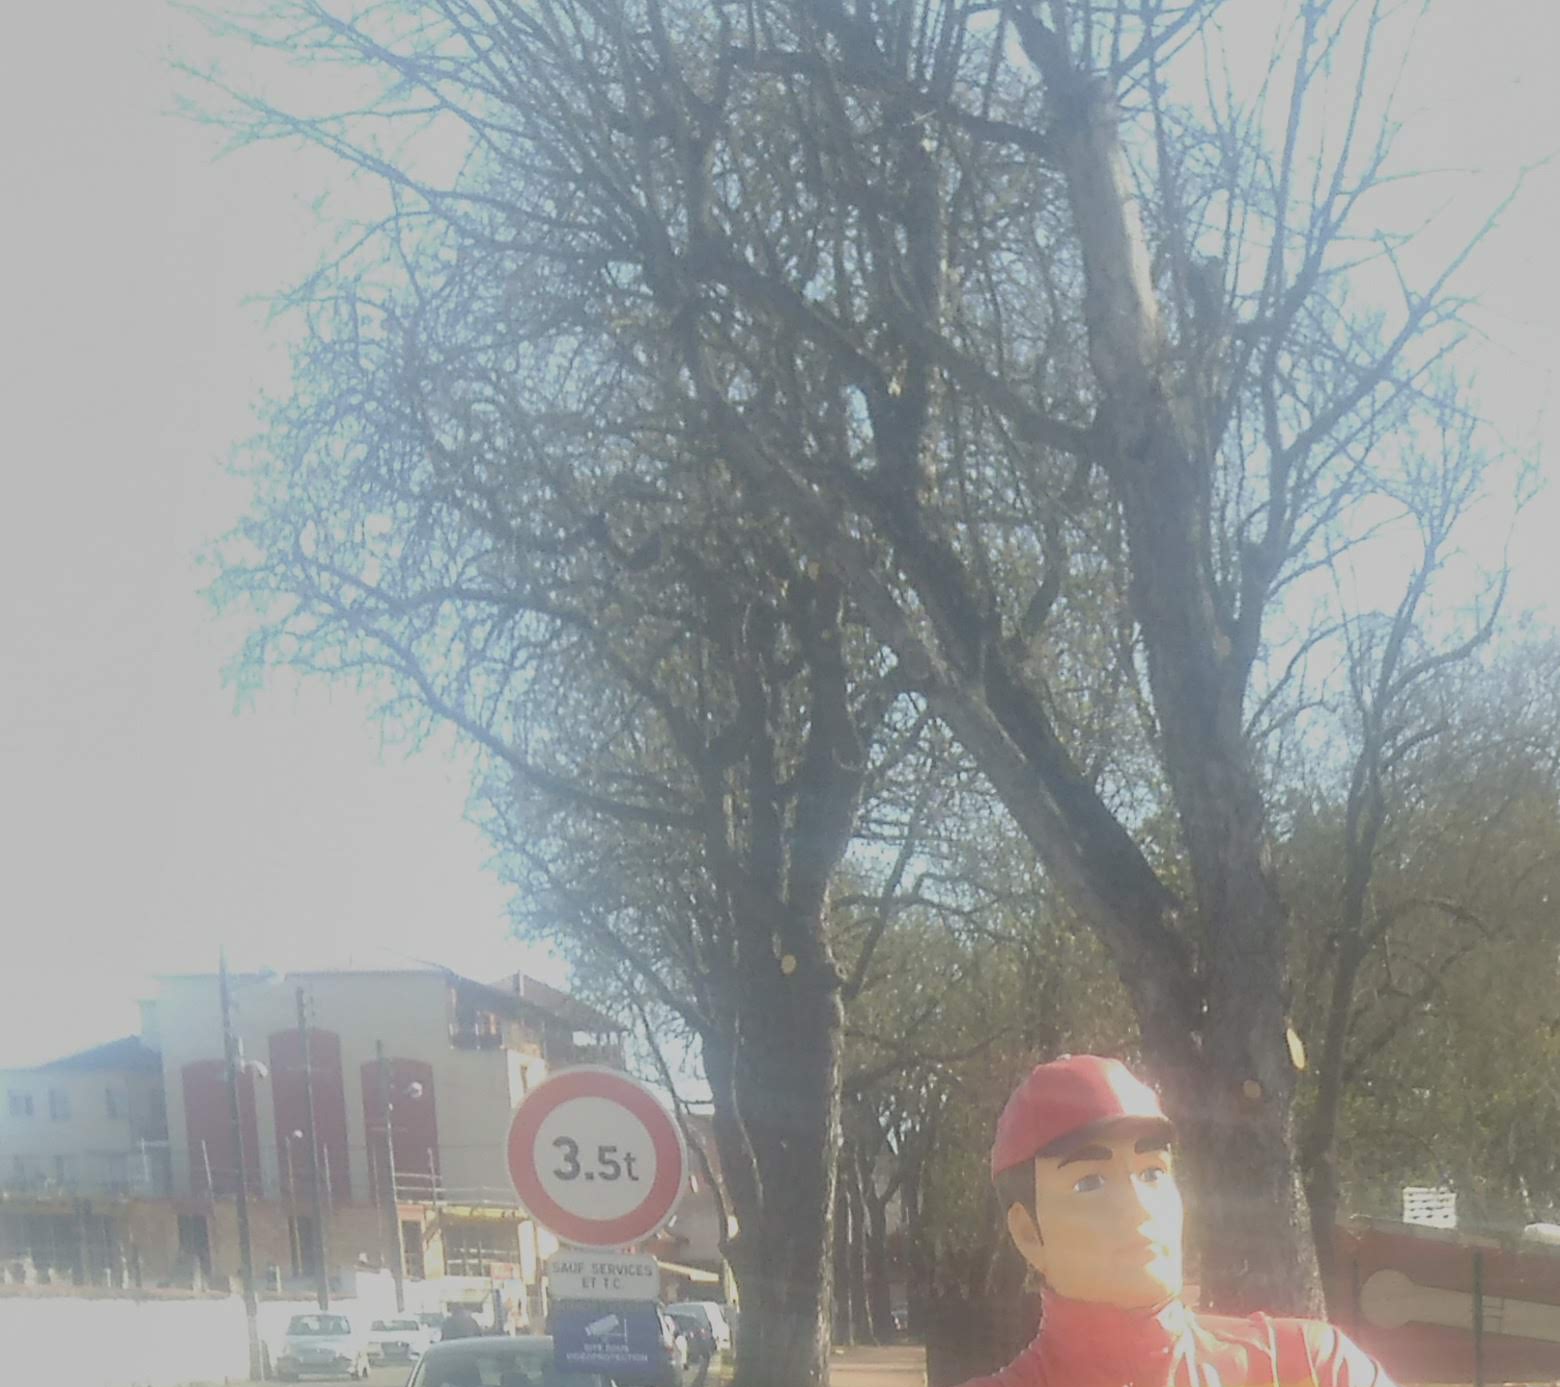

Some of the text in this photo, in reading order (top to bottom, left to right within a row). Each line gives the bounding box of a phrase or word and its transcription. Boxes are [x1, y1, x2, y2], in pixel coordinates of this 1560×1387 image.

[552, 1262, 653, 1277] SAUF SERVICES
[581, 1277, 597, 1289] ET
